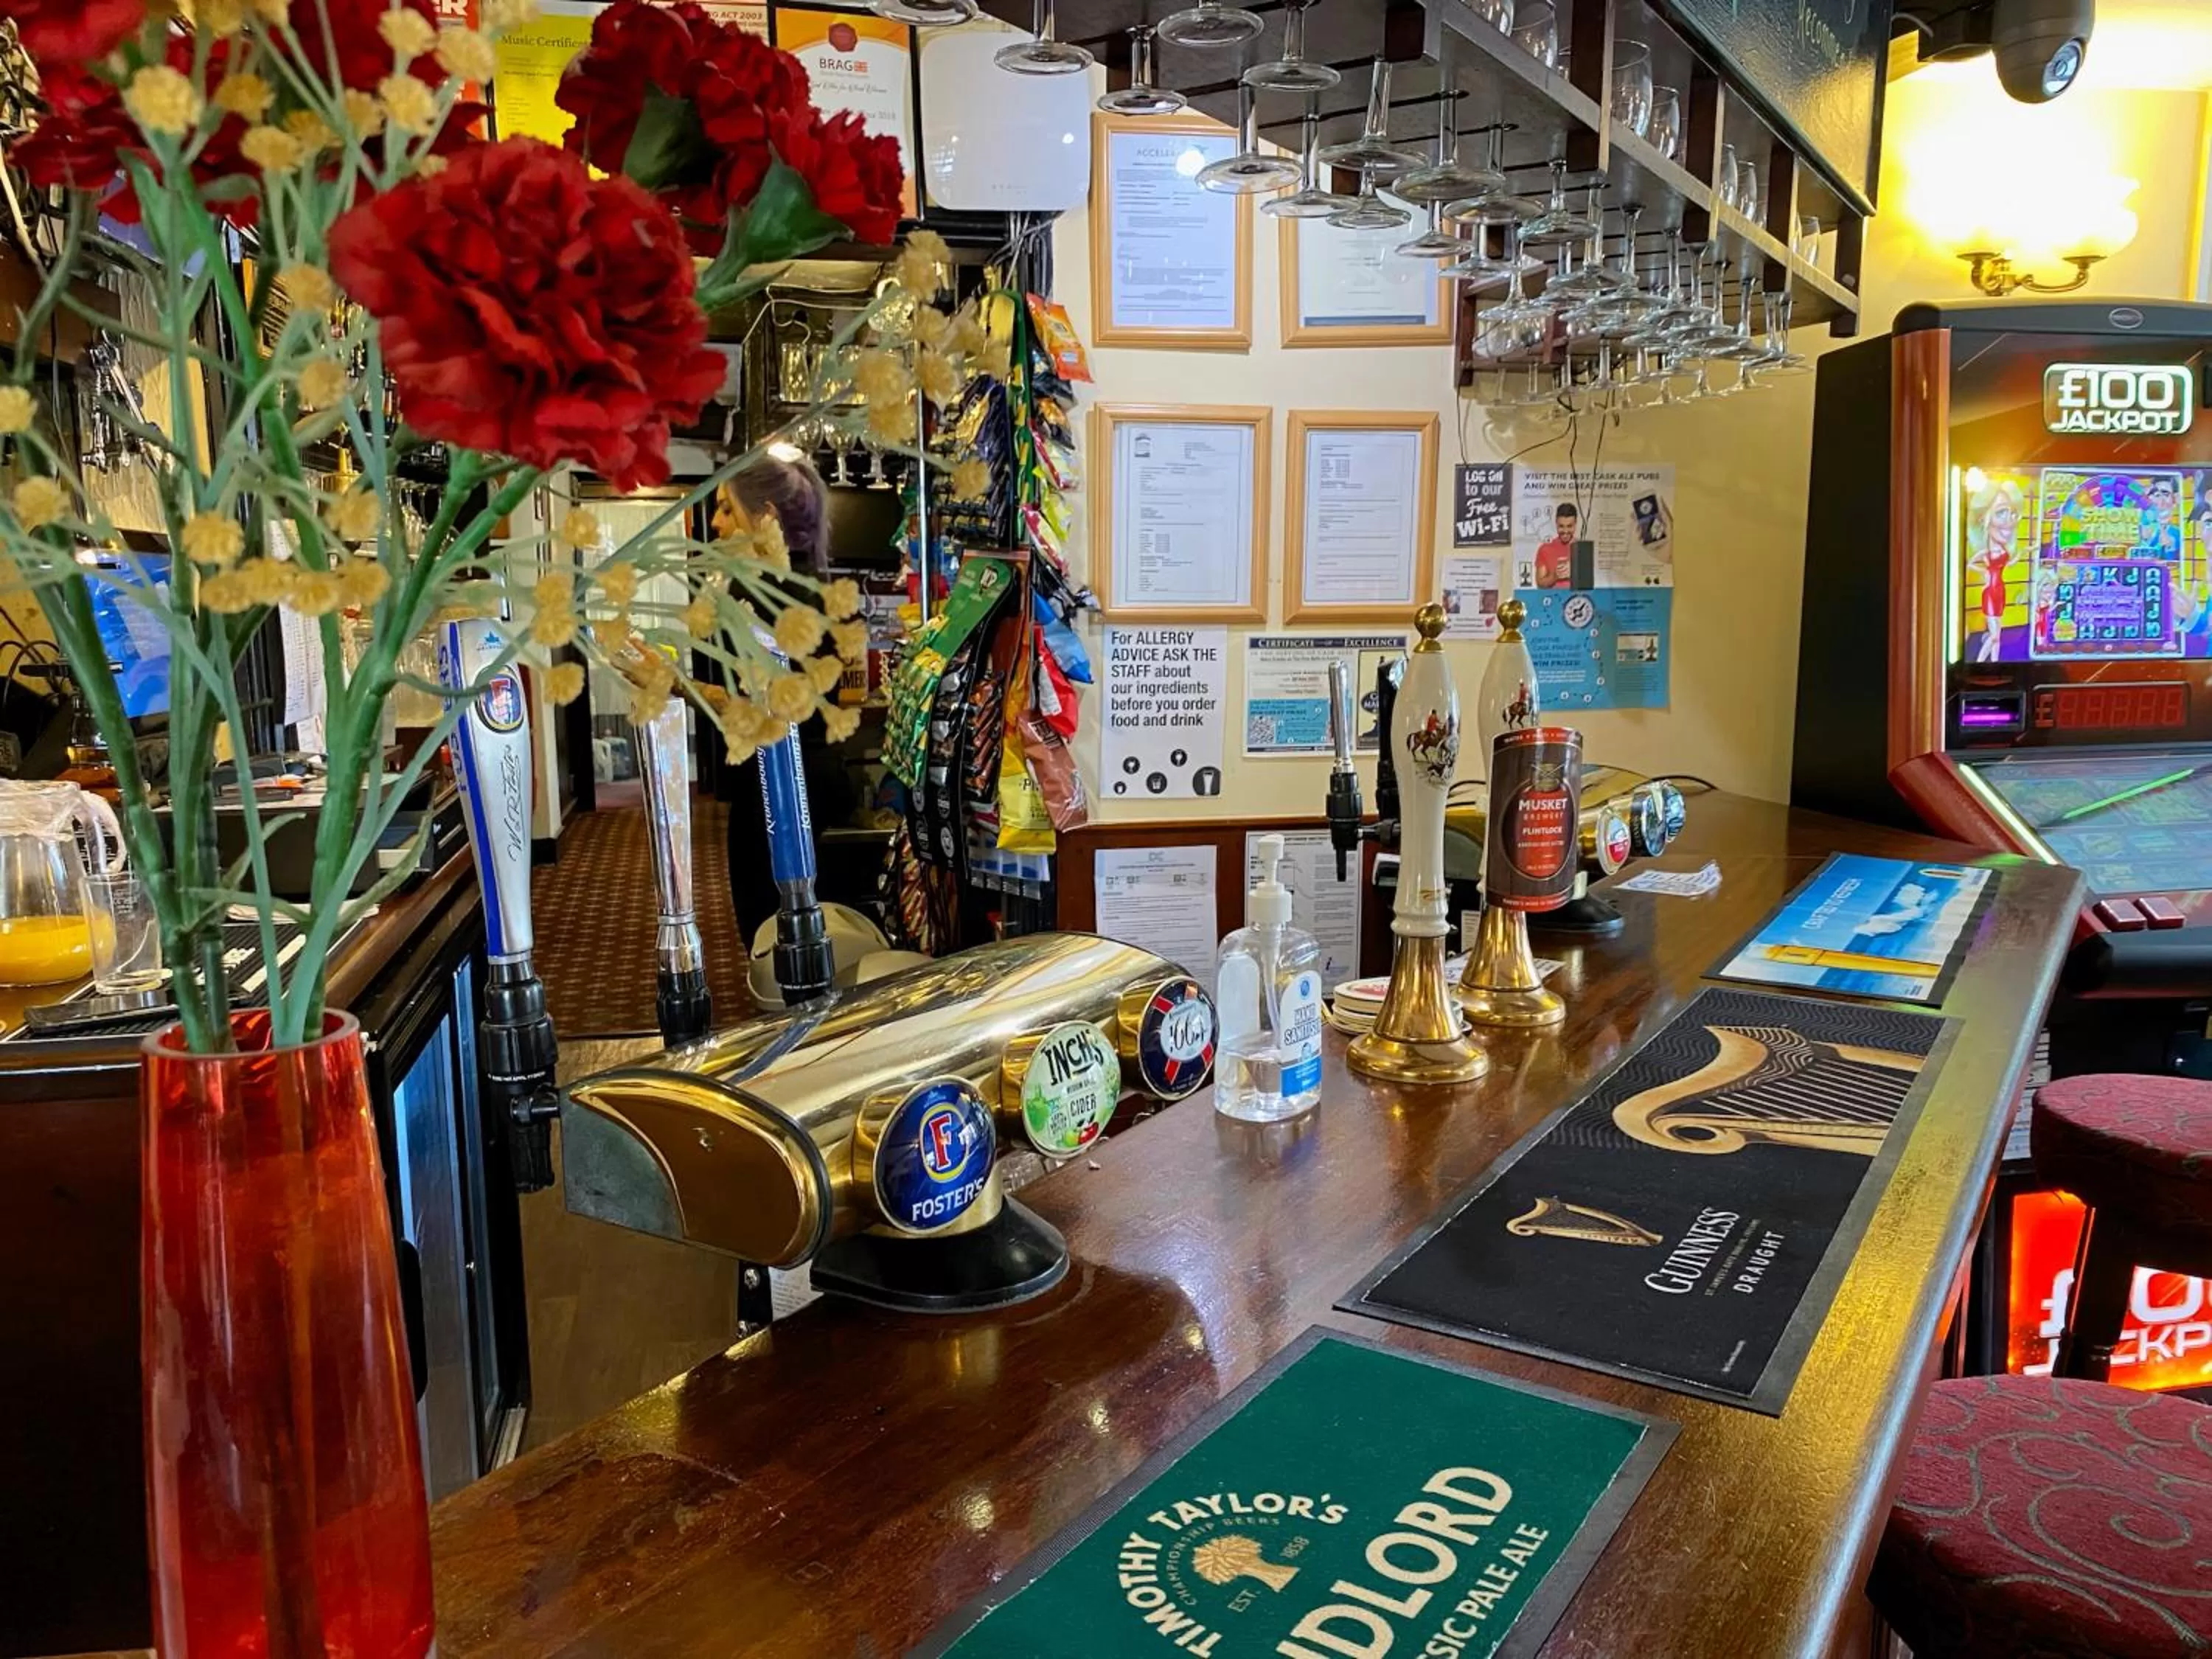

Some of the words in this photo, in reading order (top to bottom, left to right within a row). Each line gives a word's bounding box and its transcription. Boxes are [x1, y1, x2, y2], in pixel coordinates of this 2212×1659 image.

[502, 35, 535, 45] Music
[537, 37, 590, 48] Certific
[819, 58, 854, 72] BRAG
[2058, 369, 2174, 410] £100
[2051, 410, 2180, 431] JACKPOT
[1465, 470, 1486, 482] LOG
[1465, 483, 1478, 495] to
[1481, 484, 1503, 495] our
[1466, 498, 1498, 518] Free
[1456, 514, 1509, 538] Wi-Fi
[1111, 631, 1133, 645] For
[1136, 632, 1194, 645] ALLERGY
[1111, 648, 1159, 661] ADVICE
[1163, 648, 1190, 661] ASK
[1193, 648, 1217, 661] THE
[1111, 664, 1152, 678] STAFF
[1155, 665, 1192, 678] about
[1111, 684, 1133, 694] our
[1136, 681, 1208, 697] ingredients
[1111, 698, 1152, 711] before
[1156, 700, 1179, 713] you
[1182, 698, 1217, 710] order
[1111, 714, 1139, 727] food
[1143, 714, 1167, 726] and
[1170, 714, 1204, 726] drink
[1519, 798, 1568, 811] MUSKET
[1041, 1029, 1104, 1086] INCH'S
[1070, 1093, 1096, 1116] CIDER
[929, 1113, 952, 1171] F
[912, 1177, 984, 1222] FOSTER'S
[1644, 1206, 1740, 1294] GUINNESS
[1733, 1231, 1786, 1294] DRAUGHT
[1147, 1492, 1349, 1531] TAYLOR'S
[1222, 1517, 1281, 1526] BEERS
[1455, 1562, 1520, 1621] PALE
[1500, 1523, 1549, 1568] ALE
[1118, 1531, 1224, 1659] TIMOTHY
